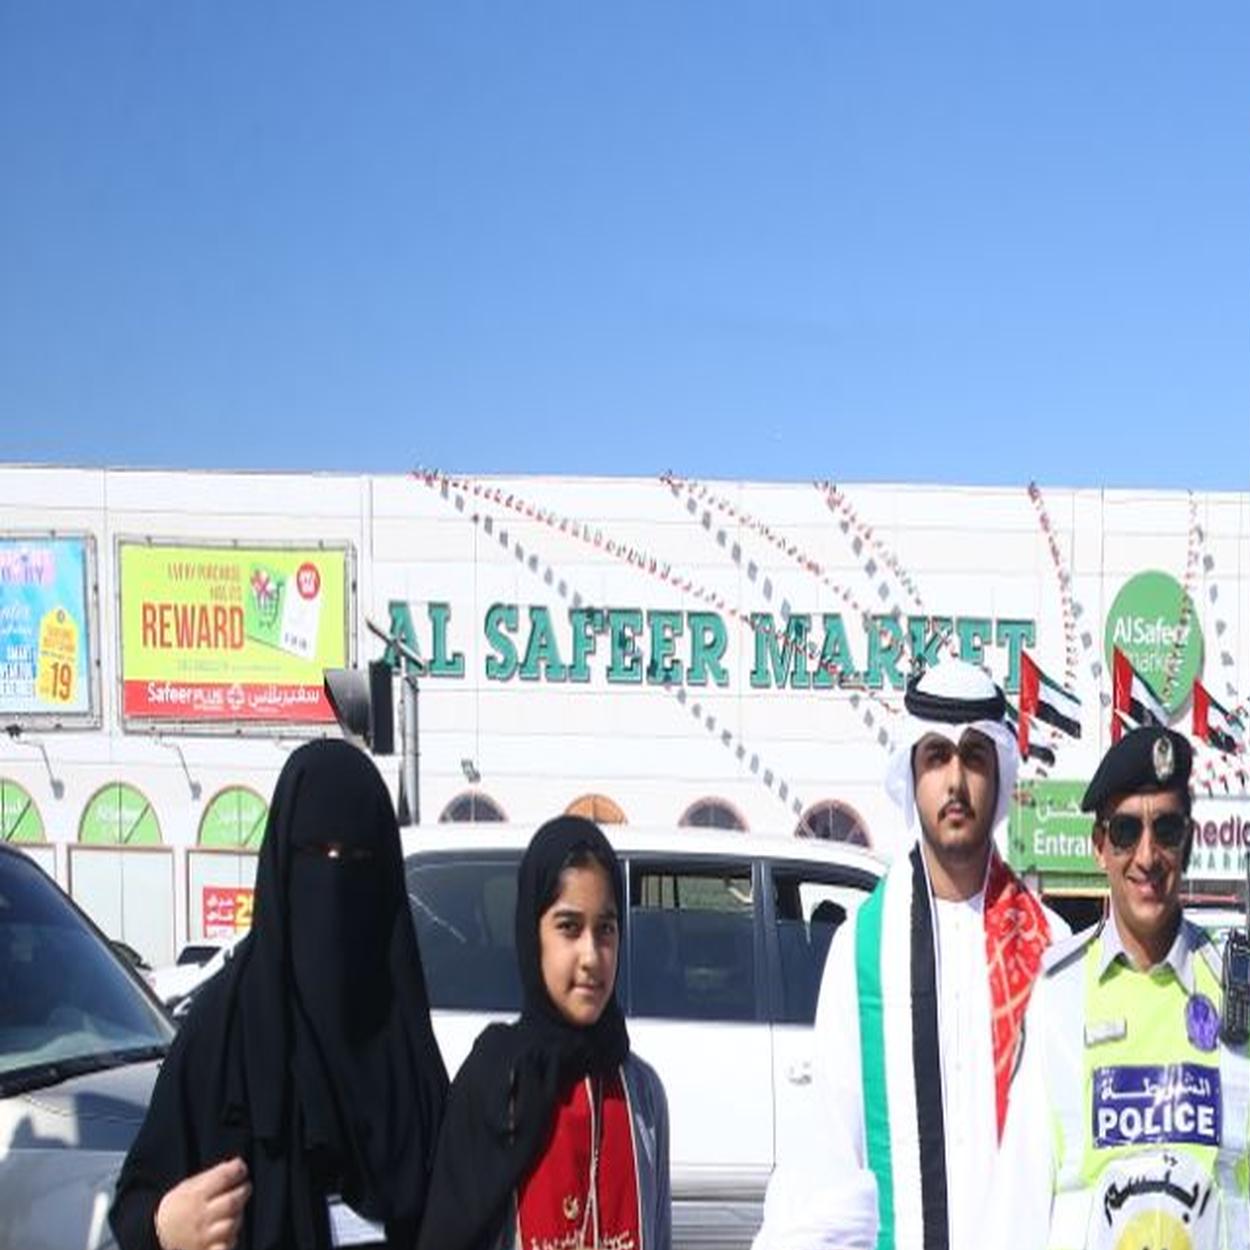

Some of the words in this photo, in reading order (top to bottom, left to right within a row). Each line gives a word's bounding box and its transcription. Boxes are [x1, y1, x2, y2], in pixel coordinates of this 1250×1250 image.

[142, 602, 244, 649] REWARD
[384, 599, 464, 679] AL
[483, 602, 730, 686] SAFEER
[50, 660, 72, 701] 19
[1097, 1102, 1216, 1140] POLICE
